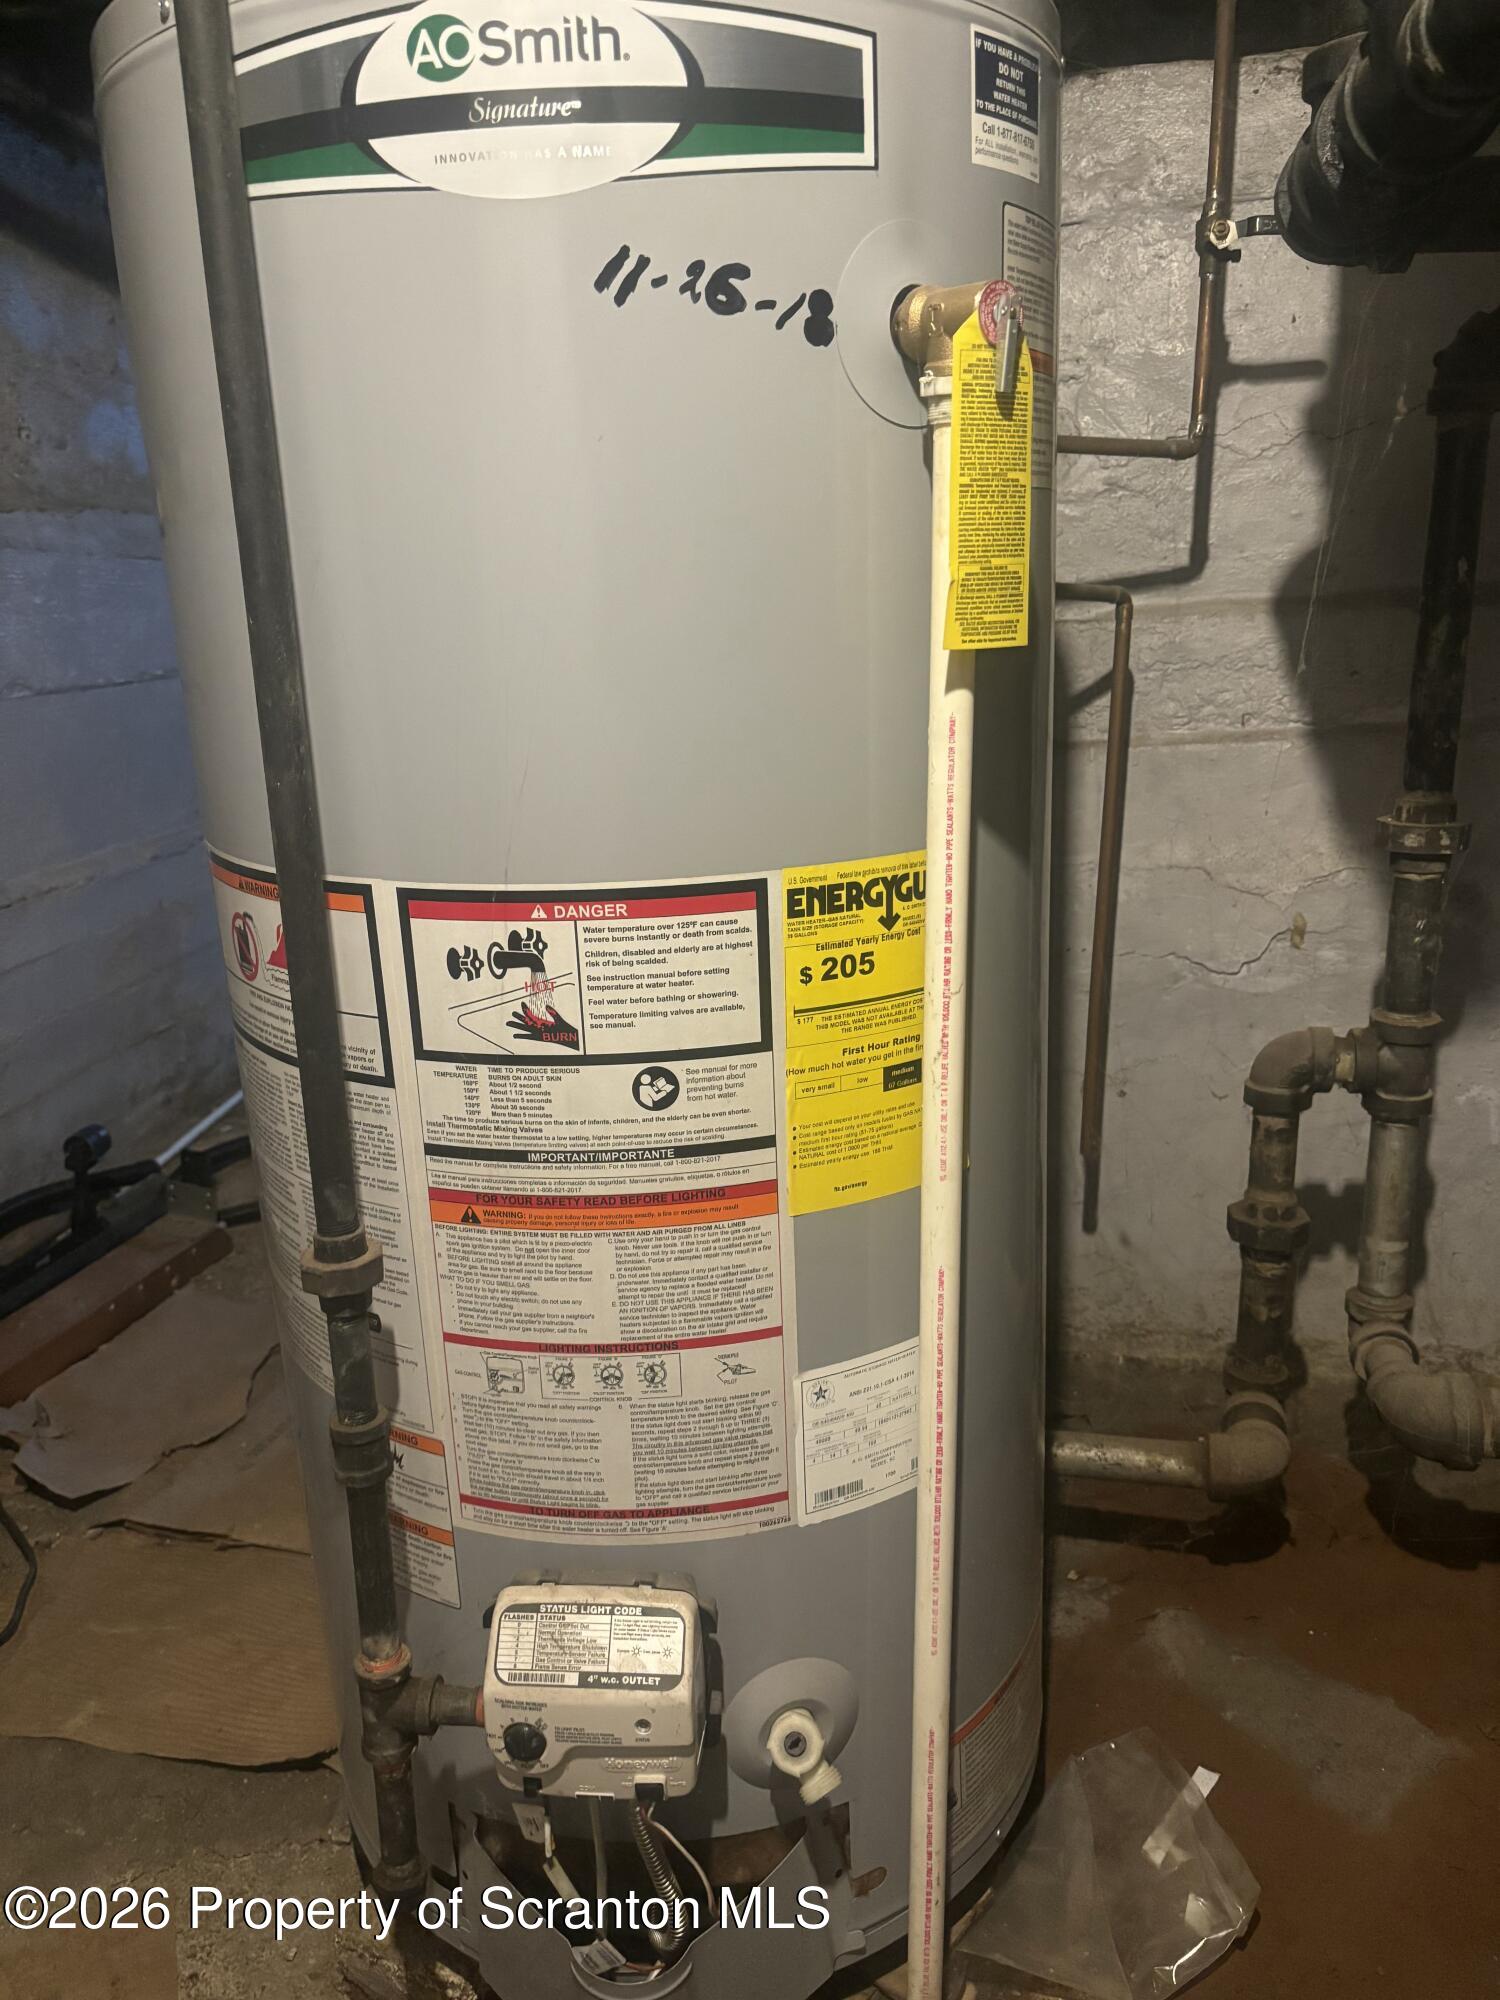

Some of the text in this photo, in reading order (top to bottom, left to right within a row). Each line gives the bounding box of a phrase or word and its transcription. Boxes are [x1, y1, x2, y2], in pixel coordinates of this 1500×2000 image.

[975, 37, 982, 48] IF
[983, 39, 997, 53] YOU
[998, 44, 1013, 60] HAVE
[998, 62, 1024, 82] DO NOT
[996, 77, 1015, 93] RETURN
[993, 90, 1011, 103] WATER
[469, 96, 572, 124] Signature
[976, 99, 984, 109] TO
[985, 101, 995, 112] THE
[996, 104, 1012, 118] PLACE
[982, 121, 995, 136] Call
[594, 244, 838, 347] 11-26-18
[553, 904, 628, 919] DANGER
[582, 926, 606, 934] Water
[607, 924, 655, 933] temperature
[715, 918, 738, 926] cause
[611, 931, 634, 942] burns
[636, 932, 670, 941] instantly
[682, 929, 704, 938] death
[725, 925, 752, 934] scalds.
[816, 926, 921, 951] Estimated Yearly Energy Cost
[584, 950, 620, 958] Children,
[621, 948, 655, 956] disabled
[657, 946, 672, 954] and
[673, 945, 700, 954] elderly
[715, 942, 723, 950] at
[724, 940, 753, 950] highest
[585, 956, 668, 967] risk of being scalded.
[799, 951, 875, 986] $ 205
[586, 967, 730, 982] See instruction manual before setting
[524, 981, 557, 993] HOT
[586, 983, 634, 992] temperature
[668, 979, 694, 987] heater.
[587, 998, 604, 1006] Feel
[605, 997, 628, 1005] water
[629, 996, 654, 1004] before
[656, 994, 685, 1002] bathing
[696, 990, 739, 999] showering.
[588, 1011, 637, 1021] Temperature
[639, 1009, 668, 1018] limiting
[669, 1008, 694, 1016] valves
[709, 1003, 745, 1012] available,
[605, 1020, 636, 1028] manual.
[542, 1031, 578, 1042] BURN
[842, 1033, 921, 1057] First Hour Rating
[455, 1064, 477, 1073] WATER
[685, 1067, 700, 1075] See
[701, 1064, 727, 1074] manual
[728, 1063, 738, 1071] for
[785, 1045, 914, 1078] (How much hot water you get in the
[432, 1070, 477, 1082] TEMPERATURE
[487, 1074, 510, 1082] BURNS
[685, 1071, 746, 1084] information about
[686, 1081, 744, 1095] preventing burns
[801, 1085, 816, 1094] very
[817, 1082, 835, 1091] small
[686, 1092, 703, 1102] from
[716, 1090, 737, 1099] water.
[425, 1119, 543, 1134] Install Thermostatic Mixing Valves
[527, 1148, 675, 1163] IMPORTANT/IMPORTANTE
[475, 1189, 726, 1206] FOR YOUR SAFETY READ BEFORE LIGHTING
[483, 1209, 526, 1220] WARNING:
[539, 1341, 679, 1353] LIGHTING INSTRUCTIONS
[547, 1508, 576, 1518] TURN
[578, 1509, 600, 1519] OFF
[603, 1510, 625, 1519] GAS
[631, 1509, 643, 1519] TO
[647, 1505, 710, 1518] APPLIANCE
[503, 1613, 535, 1621] FLASHES
[539, 1604, 643, 1616] STATUS LIGHT CODE
[622, 1676, 661, 1686] OUTLET
